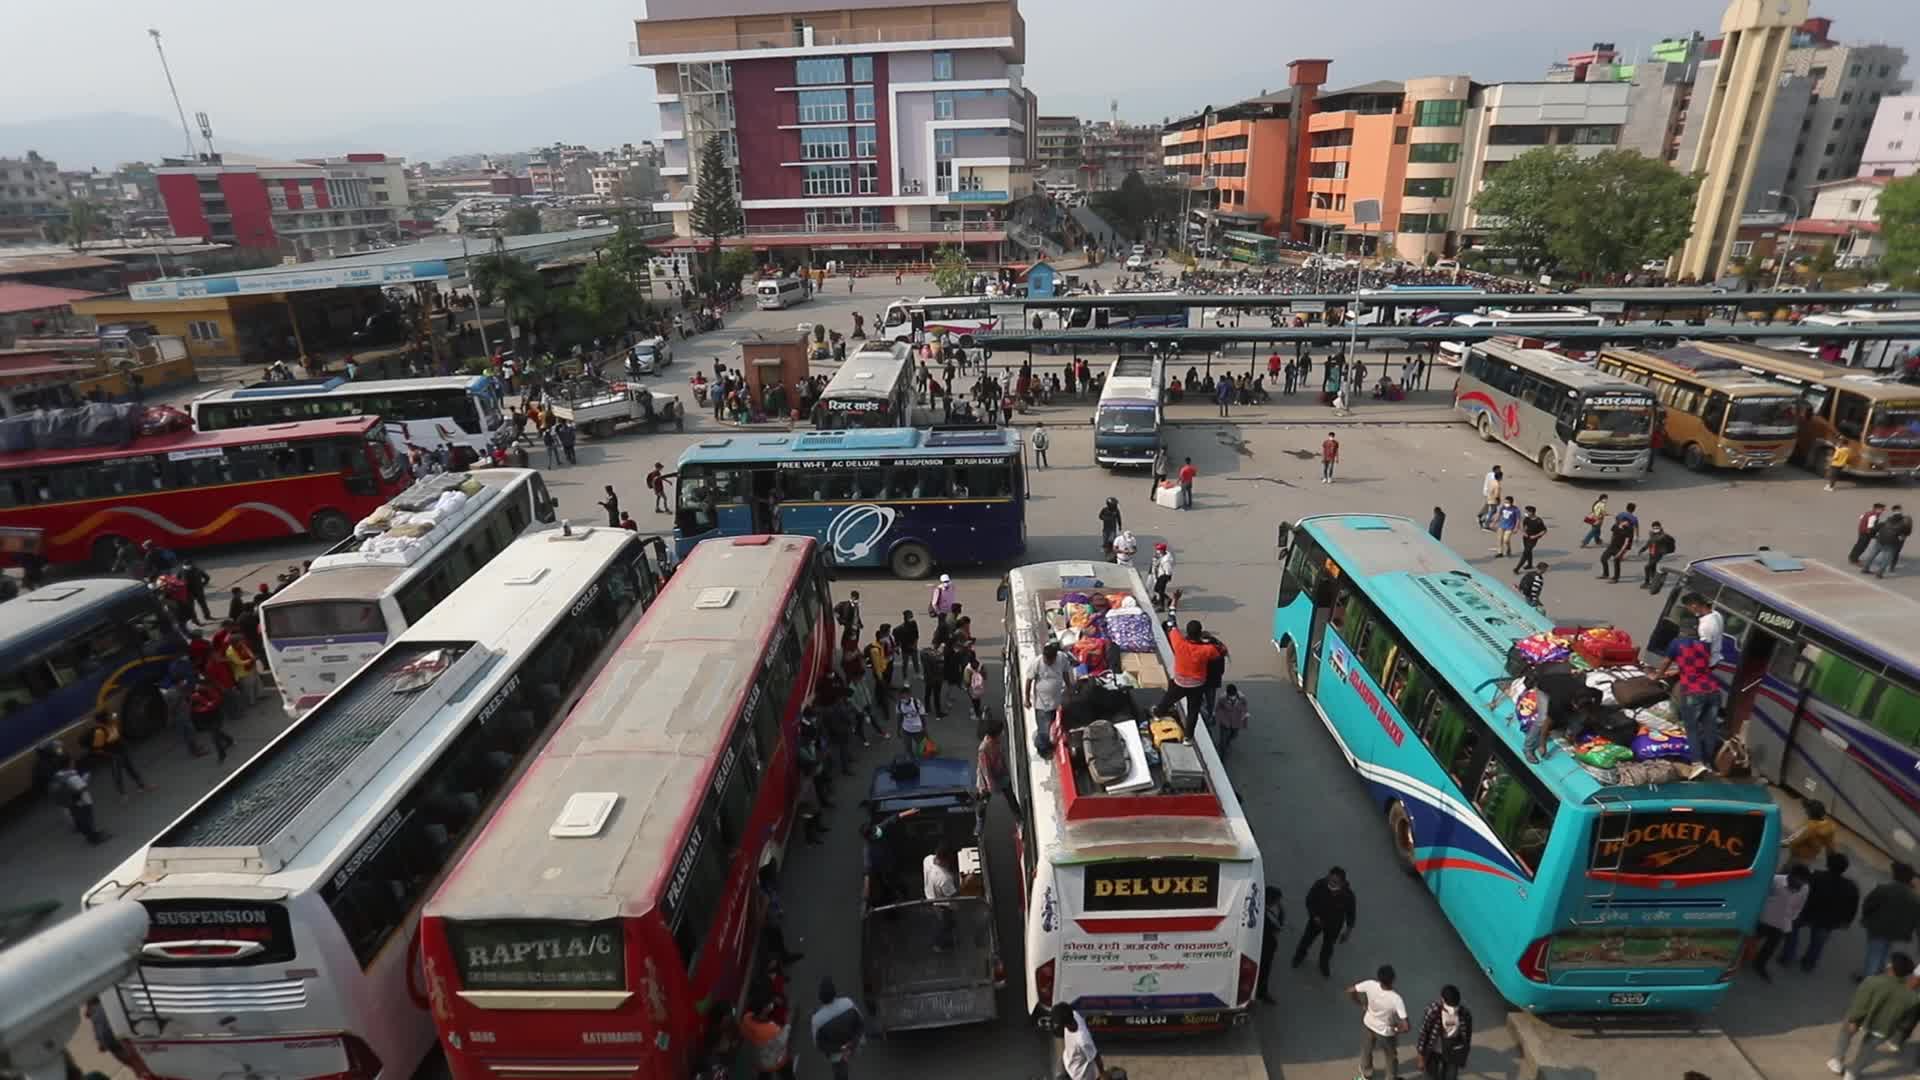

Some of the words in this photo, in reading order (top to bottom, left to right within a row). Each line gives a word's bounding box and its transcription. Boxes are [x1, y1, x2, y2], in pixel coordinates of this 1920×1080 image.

[776, 461, 800, 469] FREE
[832, 460, 843, 468] AC
[845, 459, 880, 468] DELUXE
[905, 458, 943, 466] SUSPENSION
[1757, 611, 1795, 630] PRABHU
[1602, 822, 1706, 857] ROCKET
[666, 825, 703, 908] PRASHANT
[1094, 876, 1209, 897] DELUXE
[156, 909, 267, 925] SUSPENSION
[467, 937, 562, 967] RAPTI
